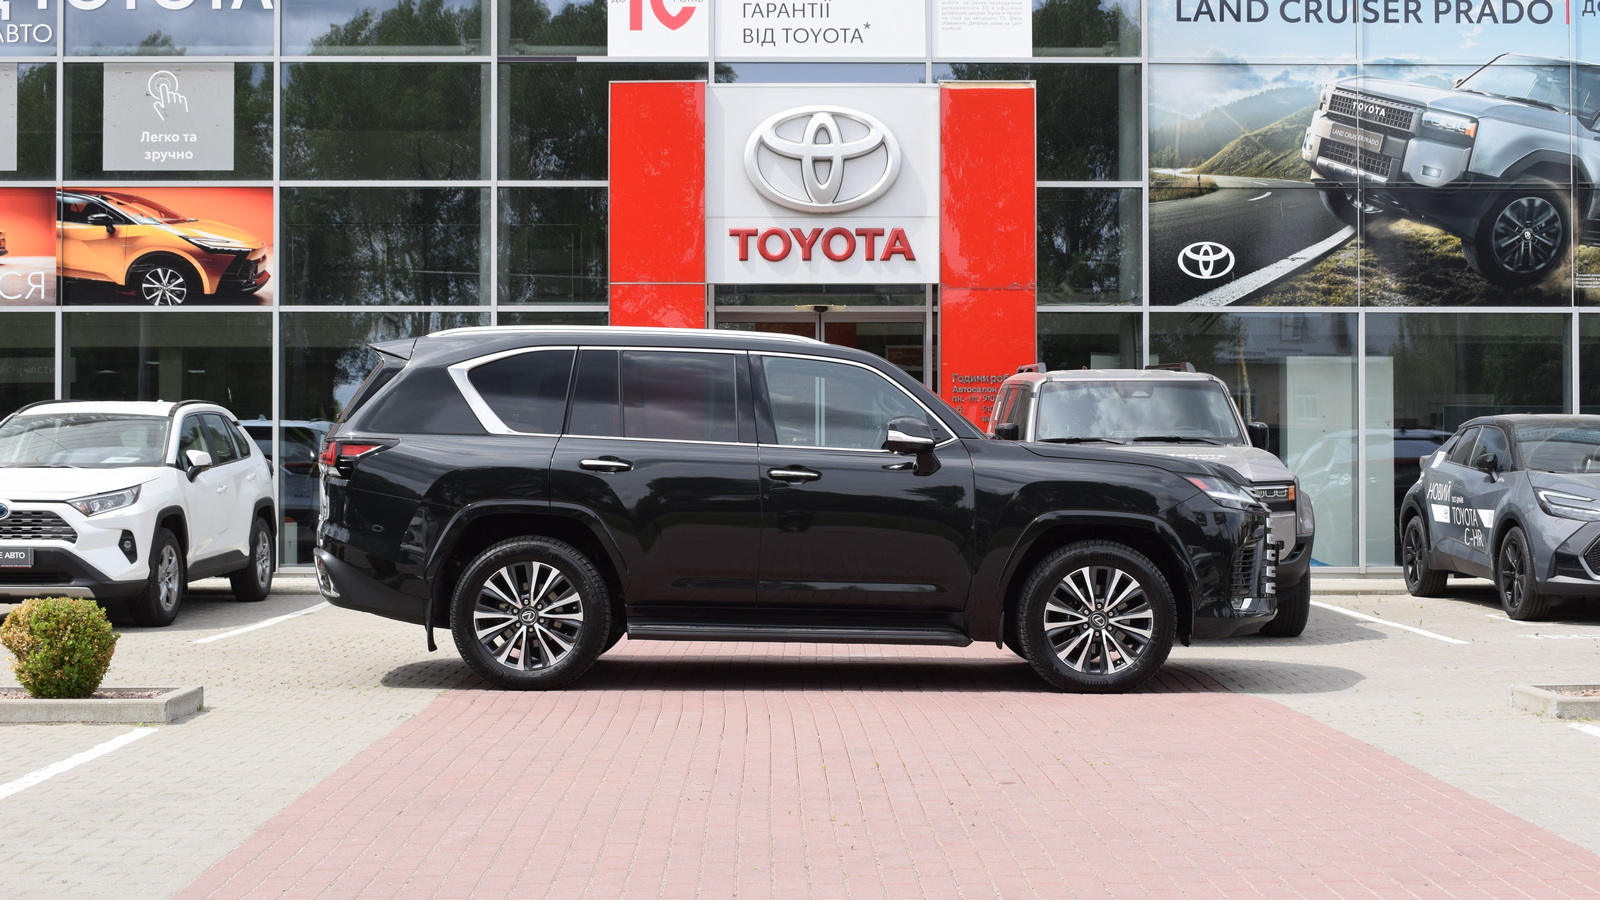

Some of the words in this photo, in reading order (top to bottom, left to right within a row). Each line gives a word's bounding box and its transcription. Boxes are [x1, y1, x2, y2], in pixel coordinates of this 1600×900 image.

[743, 0, 831, 18] ГАРАНТІЇ
[1176, 0, 1269, 22] LAND
[1279, 0, 1423, 24] CRUISER
[1434, 0, 1553, 24] PRADO
[0, 24, 53, 43] ВТО
[743, 28, 776, 47] ВІД
[1352, 101, 1386, 117] TOYOTA
[140, 131, 180, 143] Легко
[182, 133, 197, 142] та
[144, 150, 194, 162] зручно
[729, 227, 916, 262] TOYOTA
[952, 373, 988, 383] Години
[952, 385, 998, 393] Автосалон
[1452, 507, 1478, 527] TOYOTA
[1464, 527, 1485, 548] C-HR
[4, 551, 26, 560] АВТО
